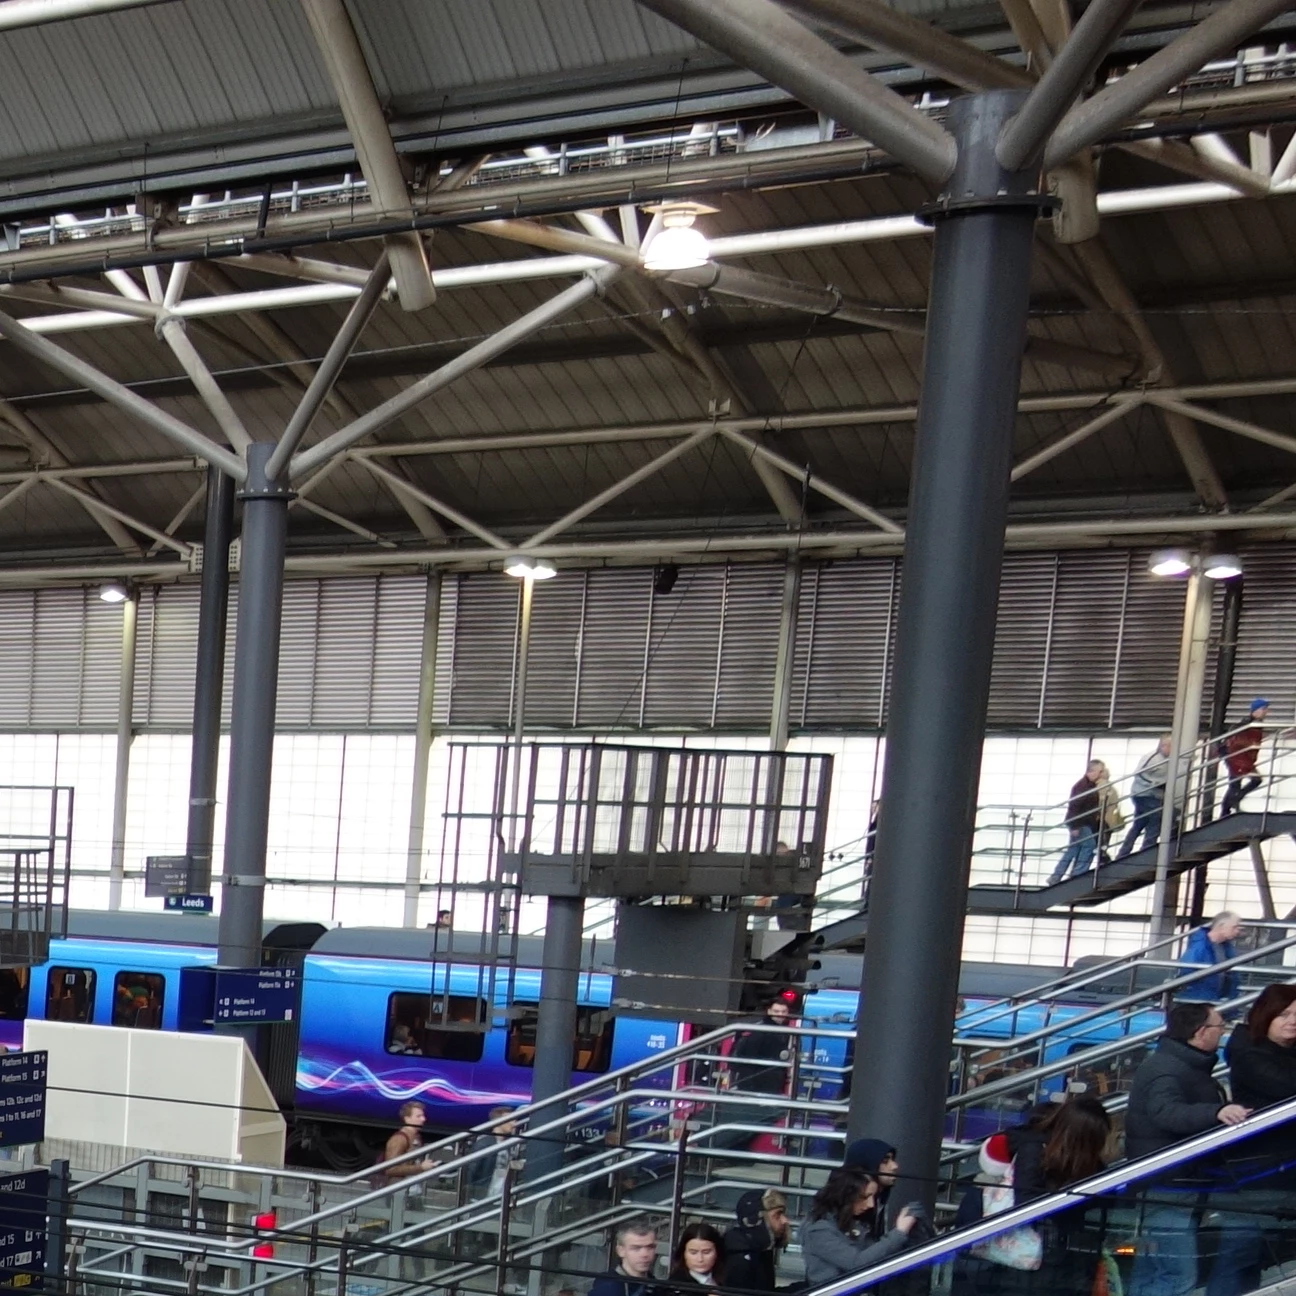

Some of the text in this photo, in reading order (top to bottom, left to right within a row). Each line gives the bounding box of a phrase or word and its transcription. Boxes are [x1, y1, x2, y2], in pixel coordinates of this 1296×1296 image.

[181, 896, 205, 908] Leeds
[1, 1058, 22, 1067] Platform
[1, 1074, 21, 1083] Platform
[13, 1179, 26, 1190] 12d
